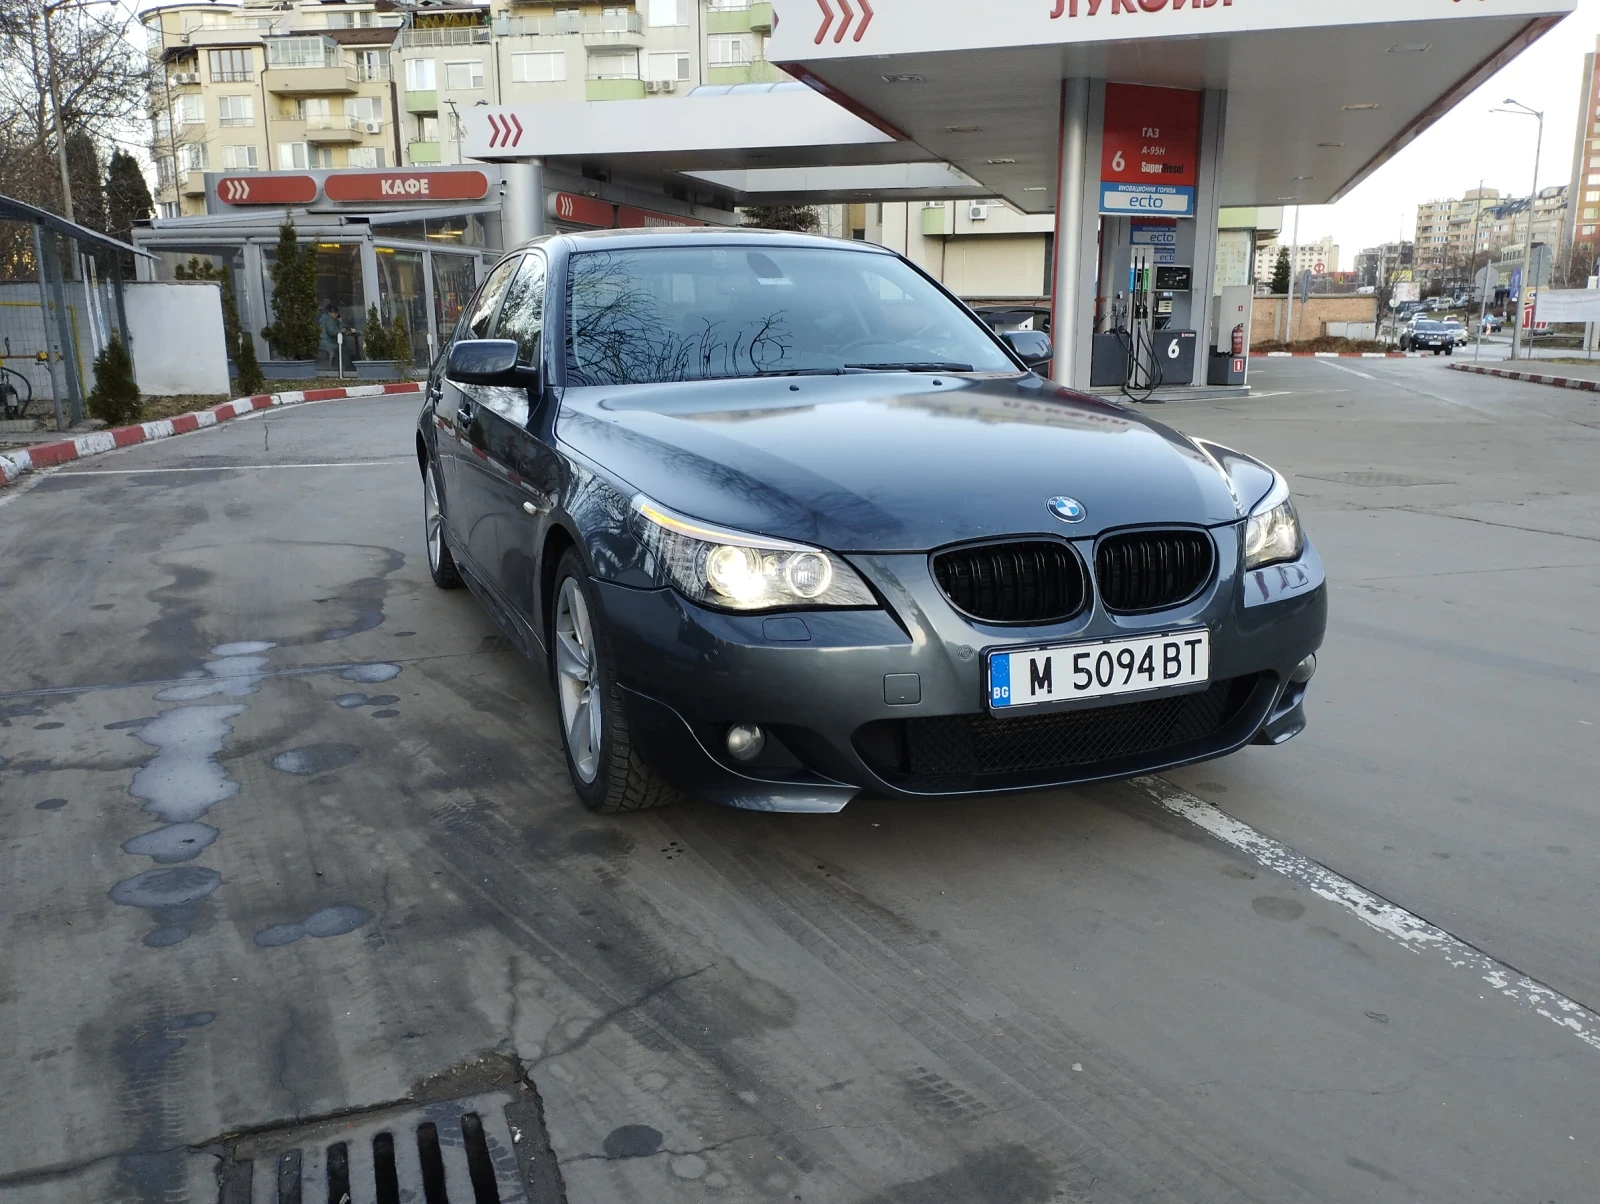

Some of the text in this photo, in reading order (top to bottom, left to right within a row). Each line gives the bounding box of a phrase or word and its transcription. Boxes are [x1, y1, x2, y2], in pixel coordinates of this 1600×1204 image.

[1142, 127, 1160, 138] ГАЗ
[1141, 146, 1166, 155] А-95Н
[1112, 151, 1125, 172] 6
[381, 178, 429, 195] КАФЕ
[1129, 194, 1163, 208] ecto
[1150, 232, 1174, 242] ecto
[1168, 338, 1180, 359] 6
[1030, 656, 1053, 696] M
[993, 686, 1009, 699] BG
